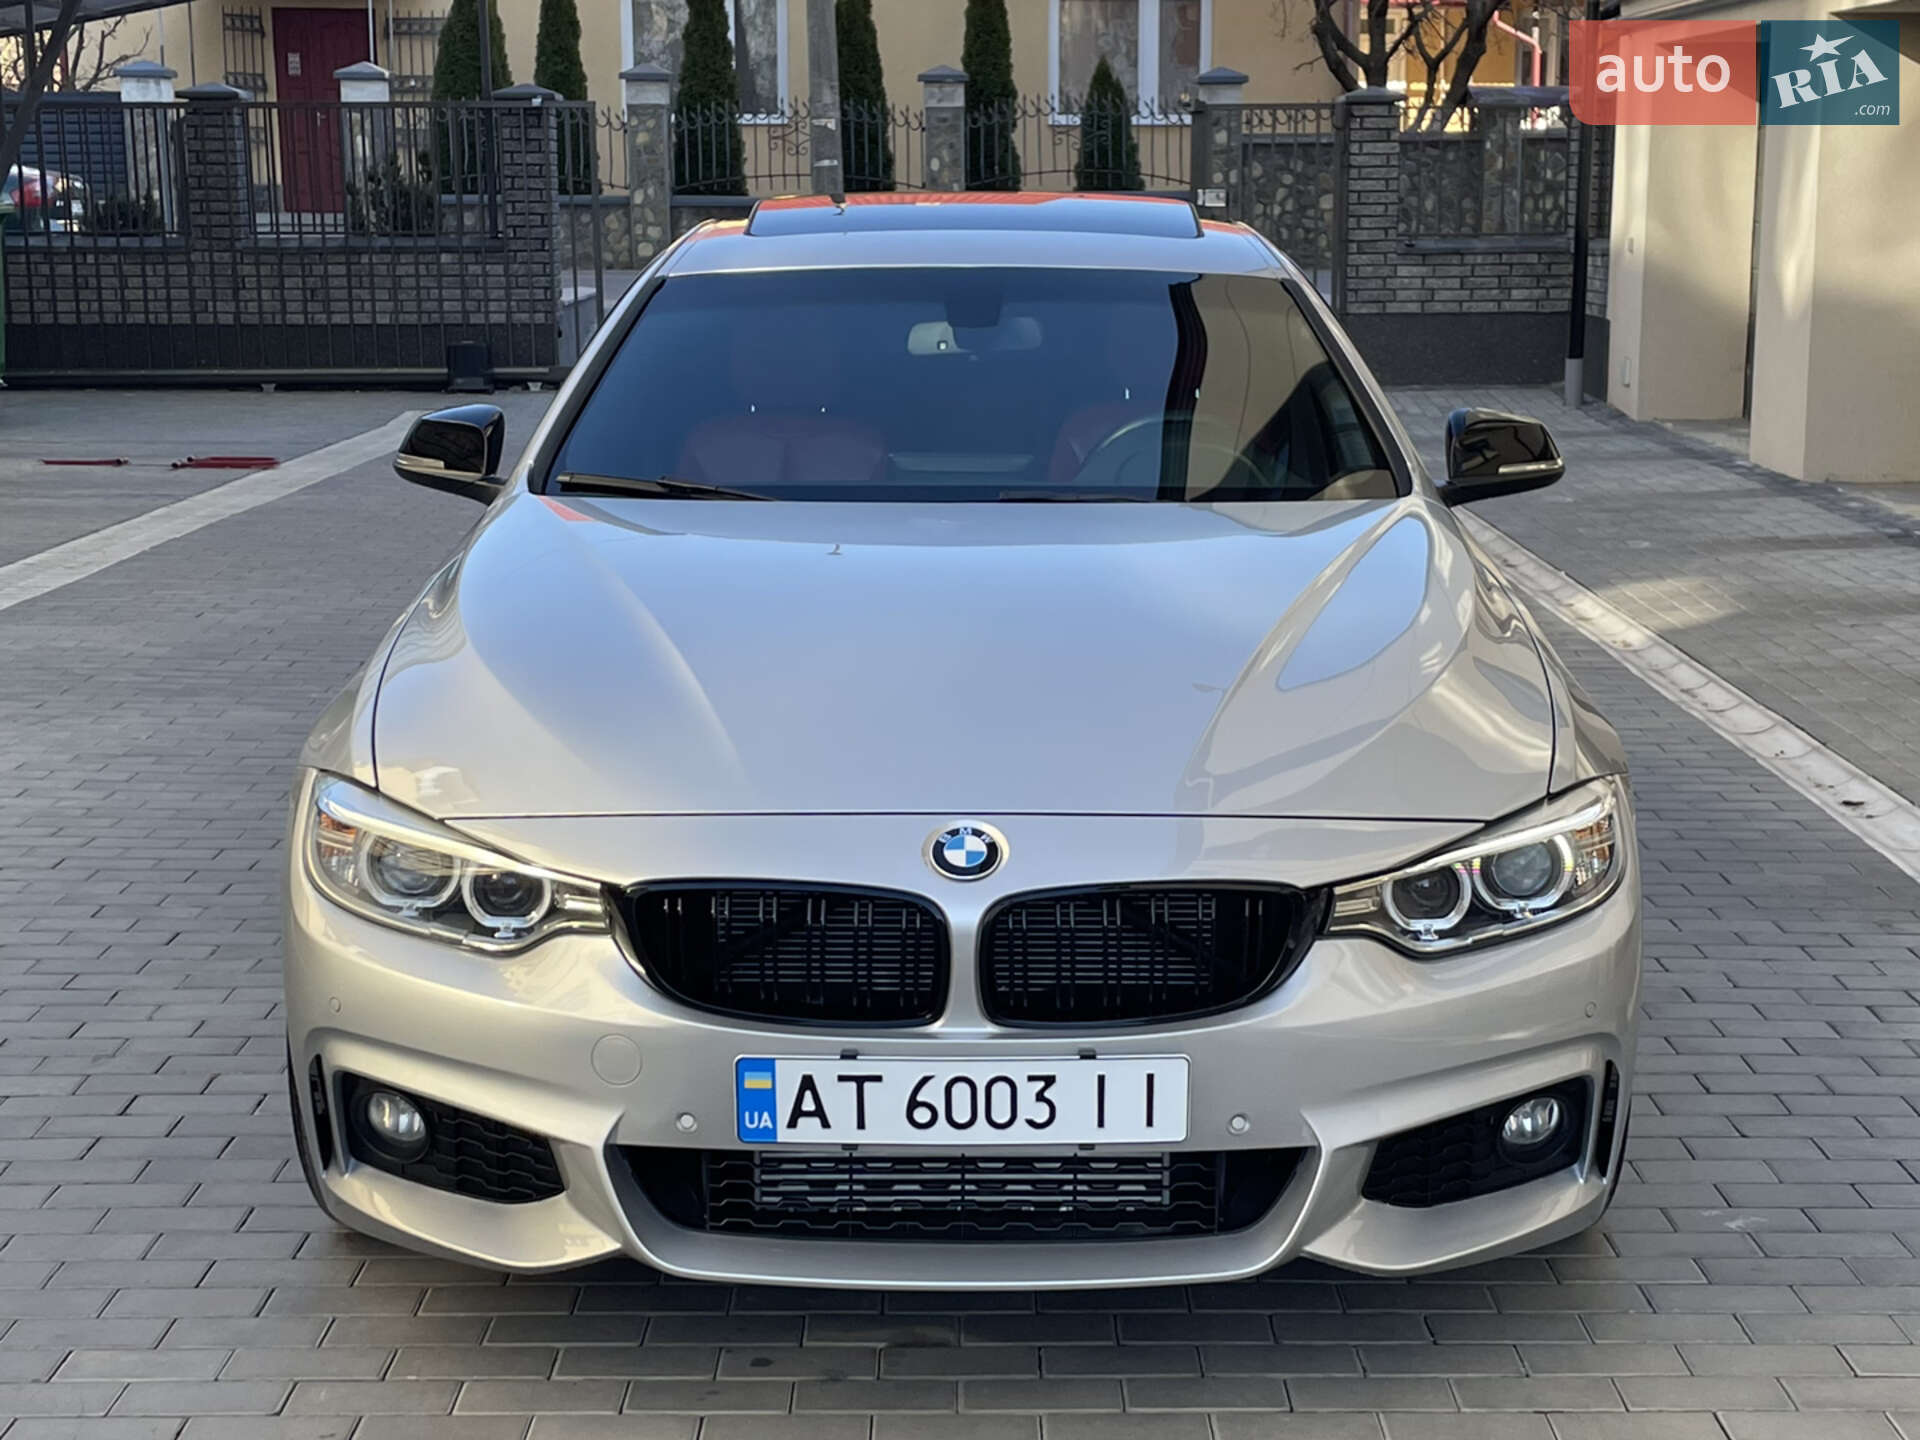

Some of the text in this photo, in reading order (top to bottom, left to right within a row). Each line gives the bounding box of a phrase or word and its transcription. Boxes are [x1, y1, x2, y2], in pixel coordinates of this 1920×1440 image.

[938, 827, 993, 844] BMW
[786, 1074, 883, 1130] AT
[905, 1075, 1057, 1130] 6003
[744, 1112, 773, 1129] UA
